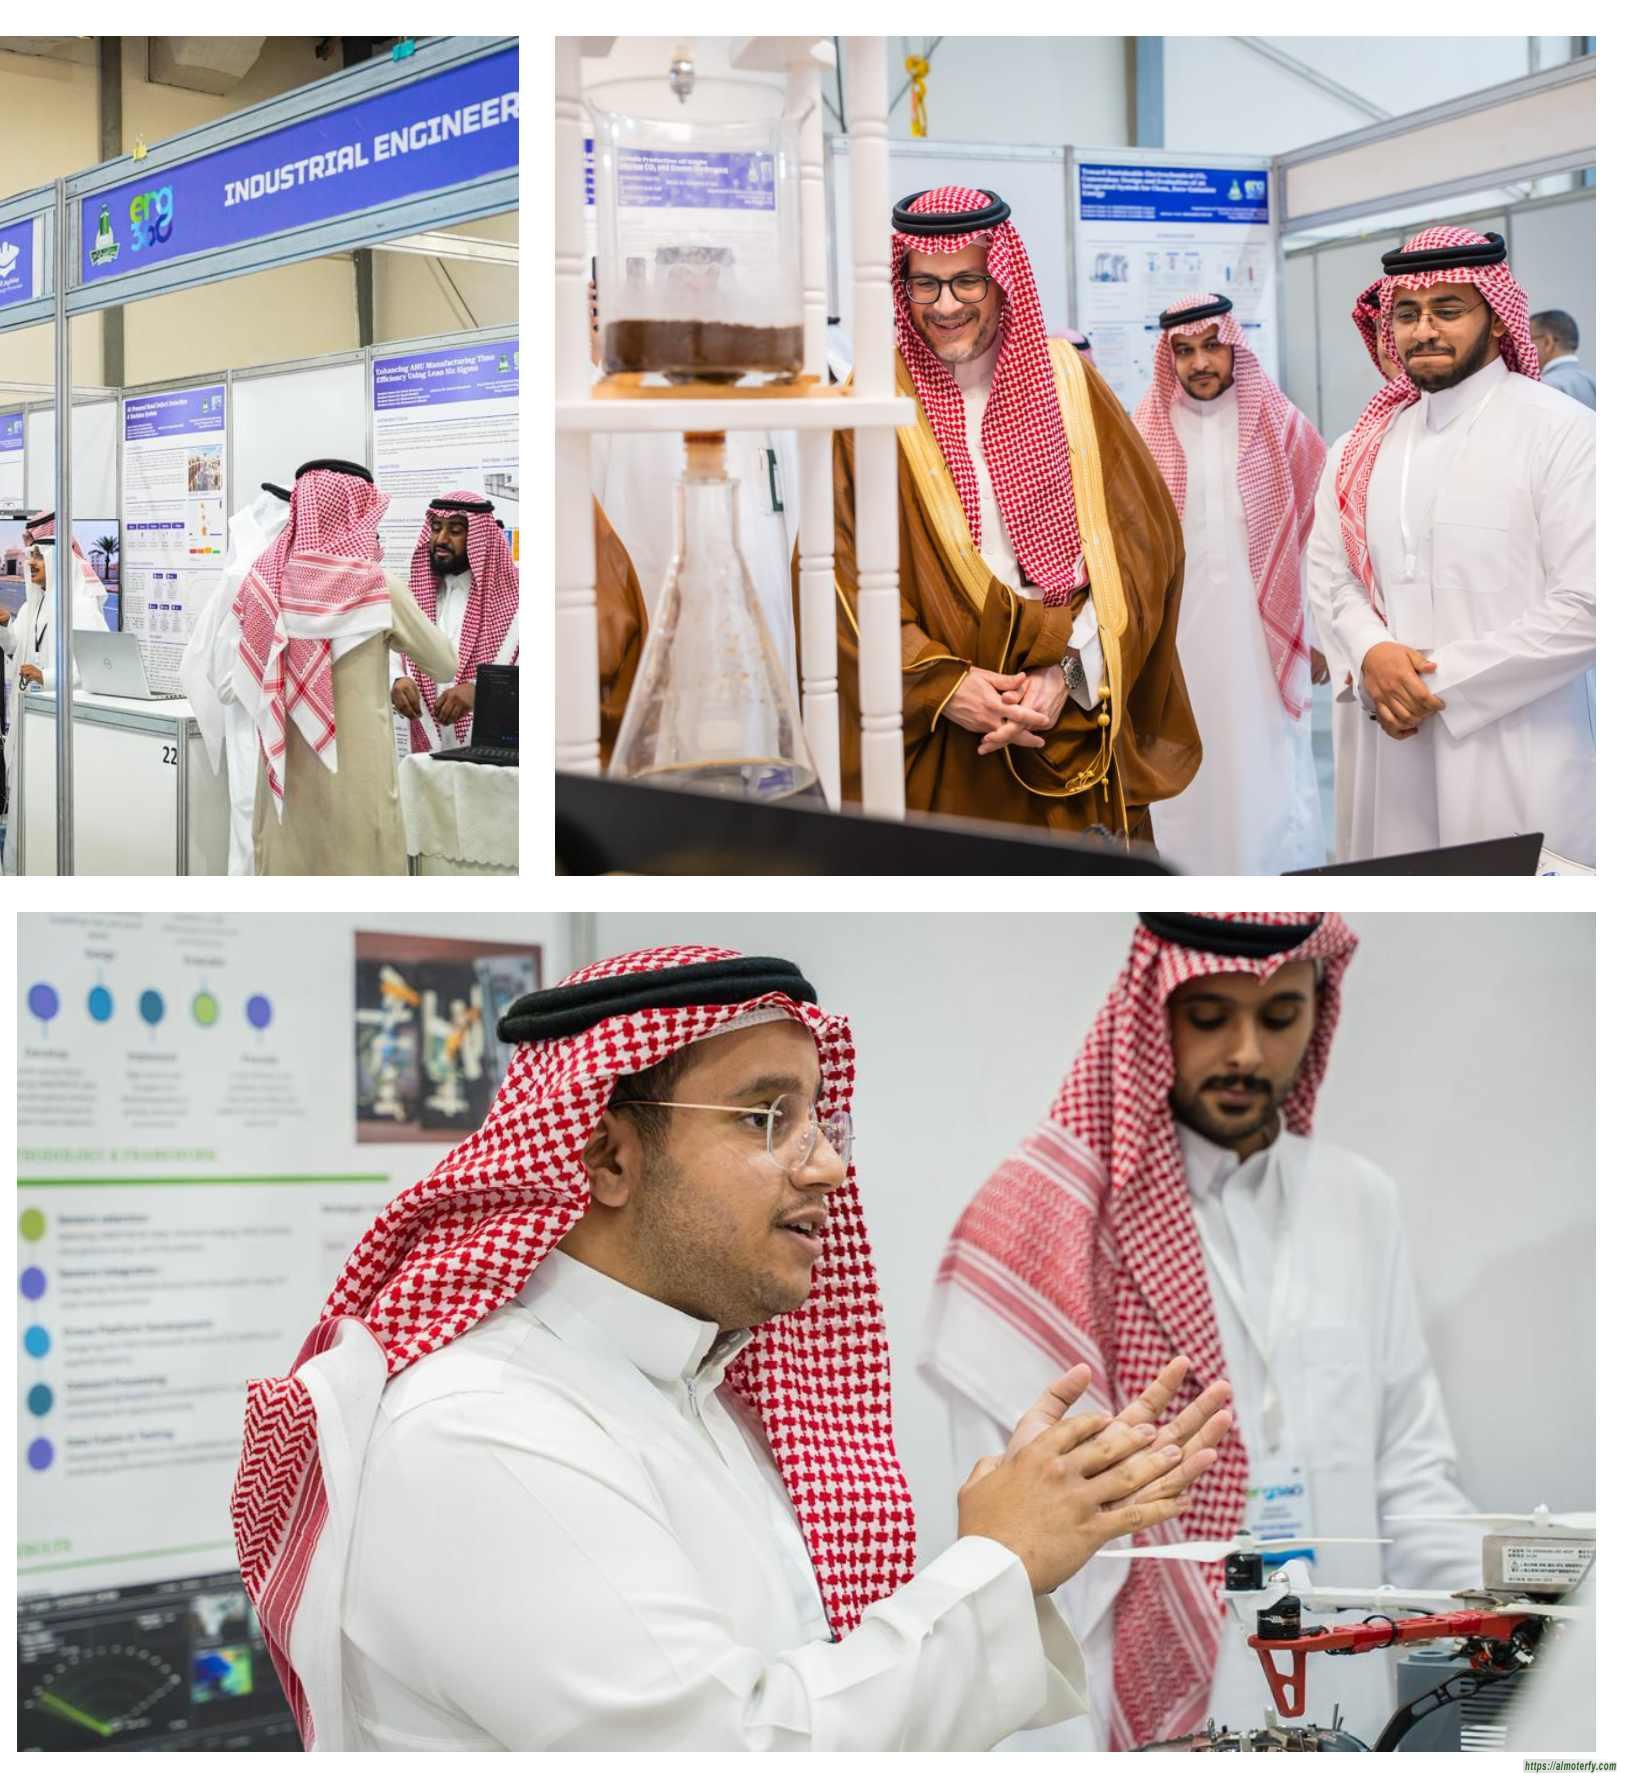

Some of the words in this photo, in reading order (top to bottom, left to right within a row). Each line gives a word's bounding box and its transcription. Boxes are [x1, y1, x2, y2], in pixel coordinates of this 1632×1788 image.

[224, 143, 369, 207] INDUSTRIAL
[374, 91, 519, 163] ENGINEER
[163, 745, 177, 765] 22
